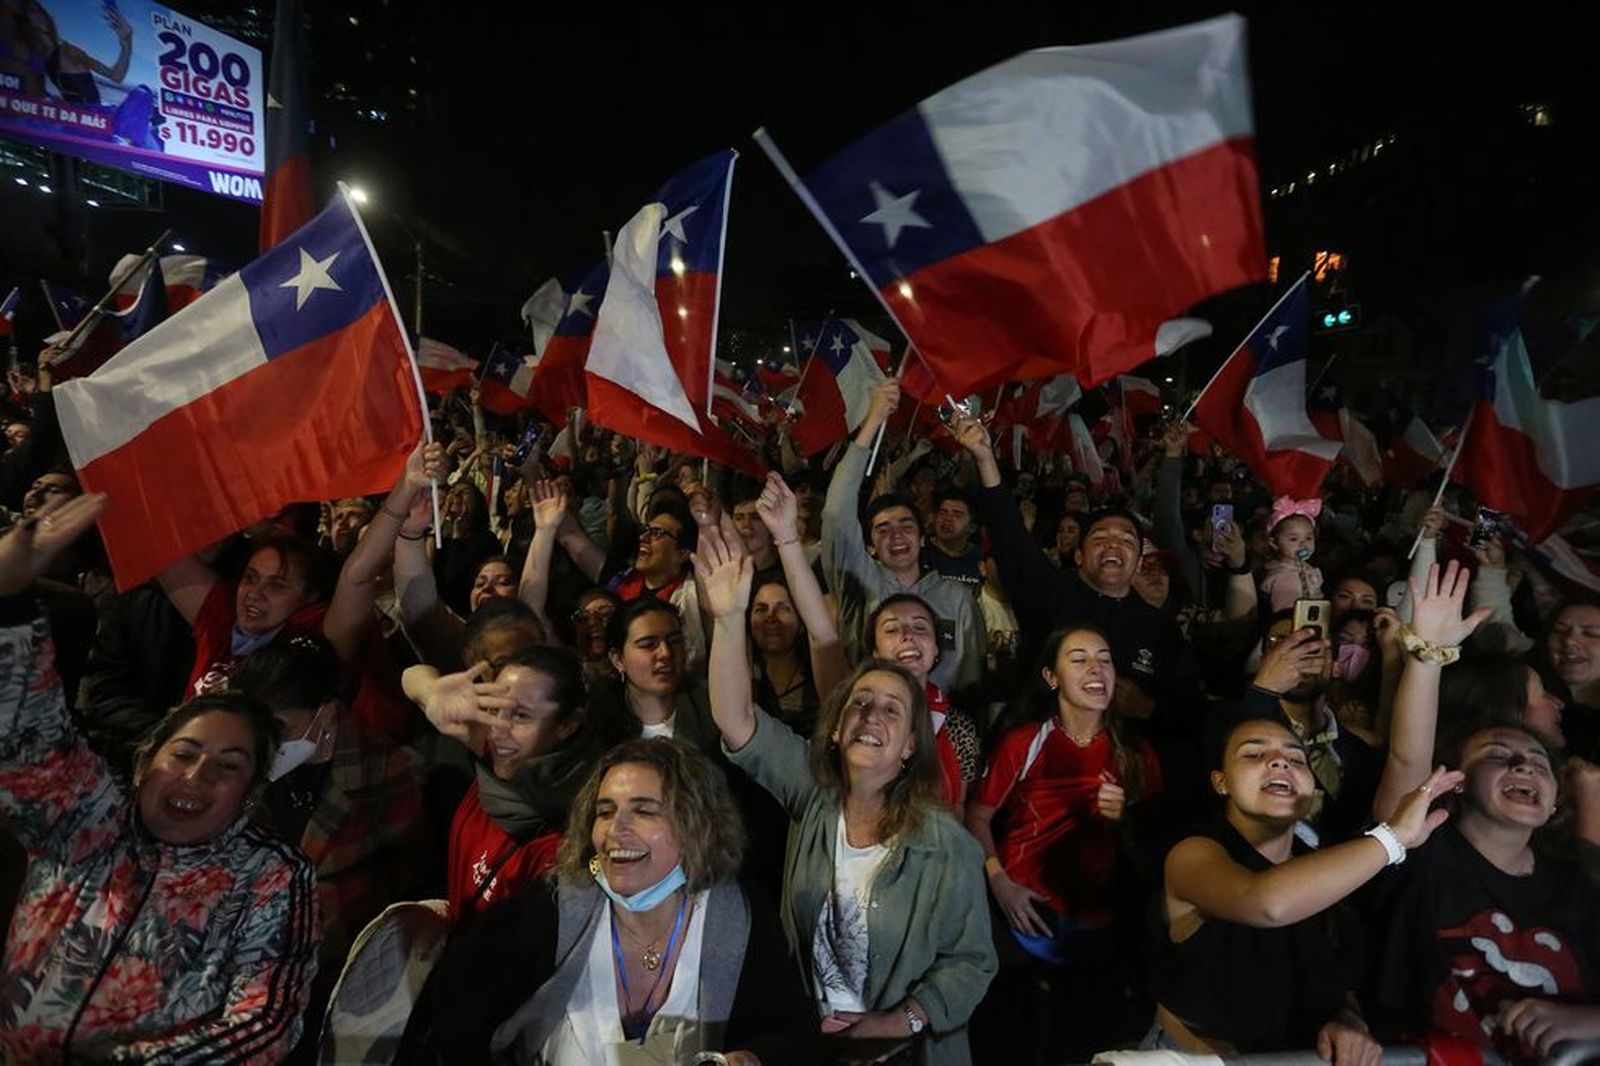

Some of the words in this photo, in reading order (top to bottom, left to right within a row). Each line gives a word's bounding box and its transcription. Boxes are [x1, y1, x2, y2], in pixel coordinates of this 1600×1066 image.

[153, 13, 192, 37] PLAN
[158, 31, 250, 88] 200
[160, 64, 250, 108] GIGAS
[11, 99, 38, 116] QUE
[42, 105, 57, 119] TE
[60, 109, 78, 124] DA
[80, 112, 107, 129] MÁS
[161, 126, 172, 140] $
[175, 121, 255, 156] 11.990
[208, 169, 264, 200] WOM
